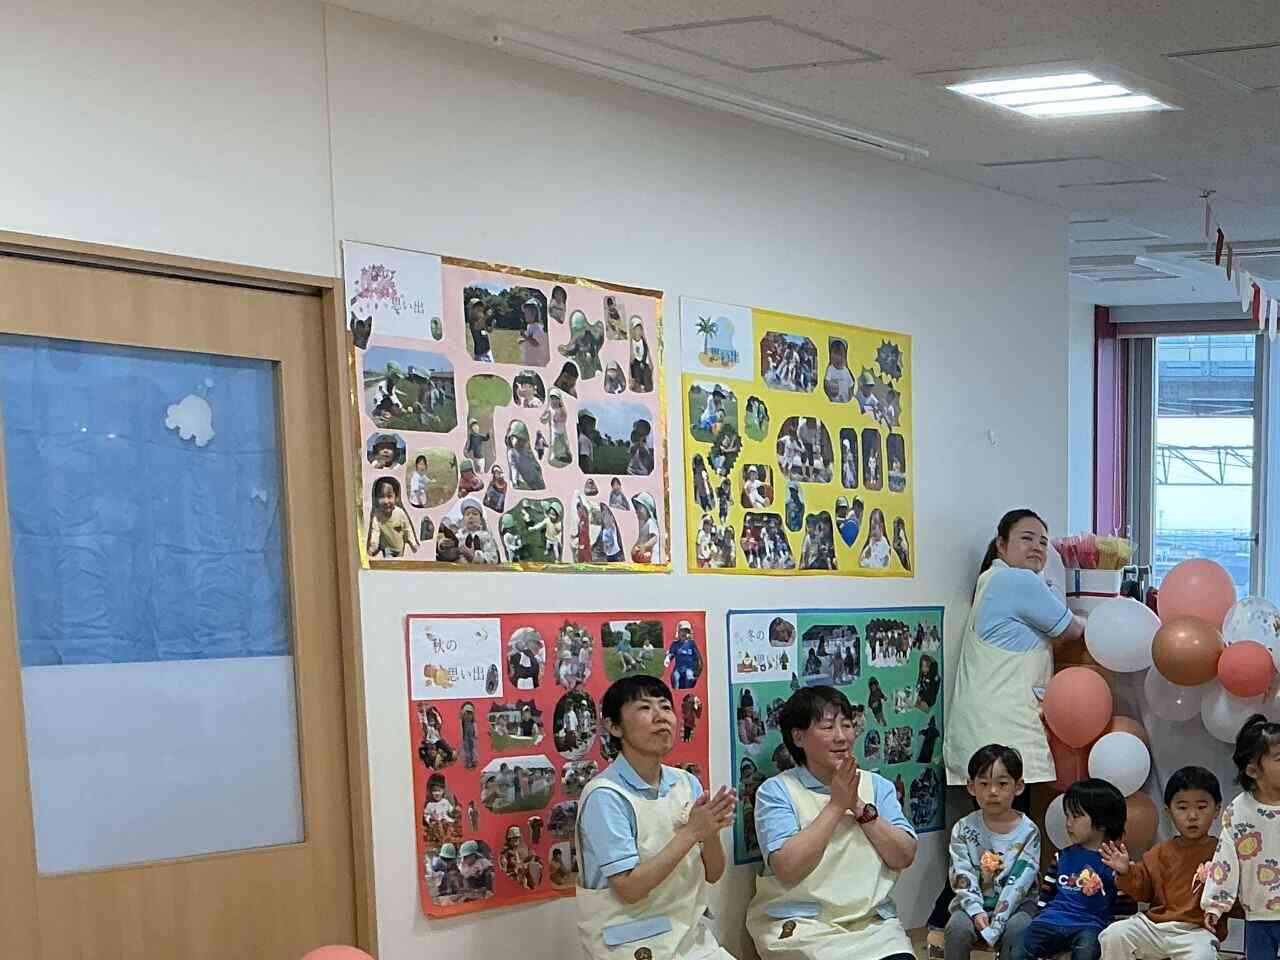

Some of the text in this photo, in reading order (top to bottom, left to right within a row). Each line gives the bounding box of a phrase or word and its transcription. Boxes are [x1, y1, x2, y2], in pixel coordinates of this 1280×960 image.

[431, 635, 457, 653] 秋の
[447, 666, 485, 682] 思い出
